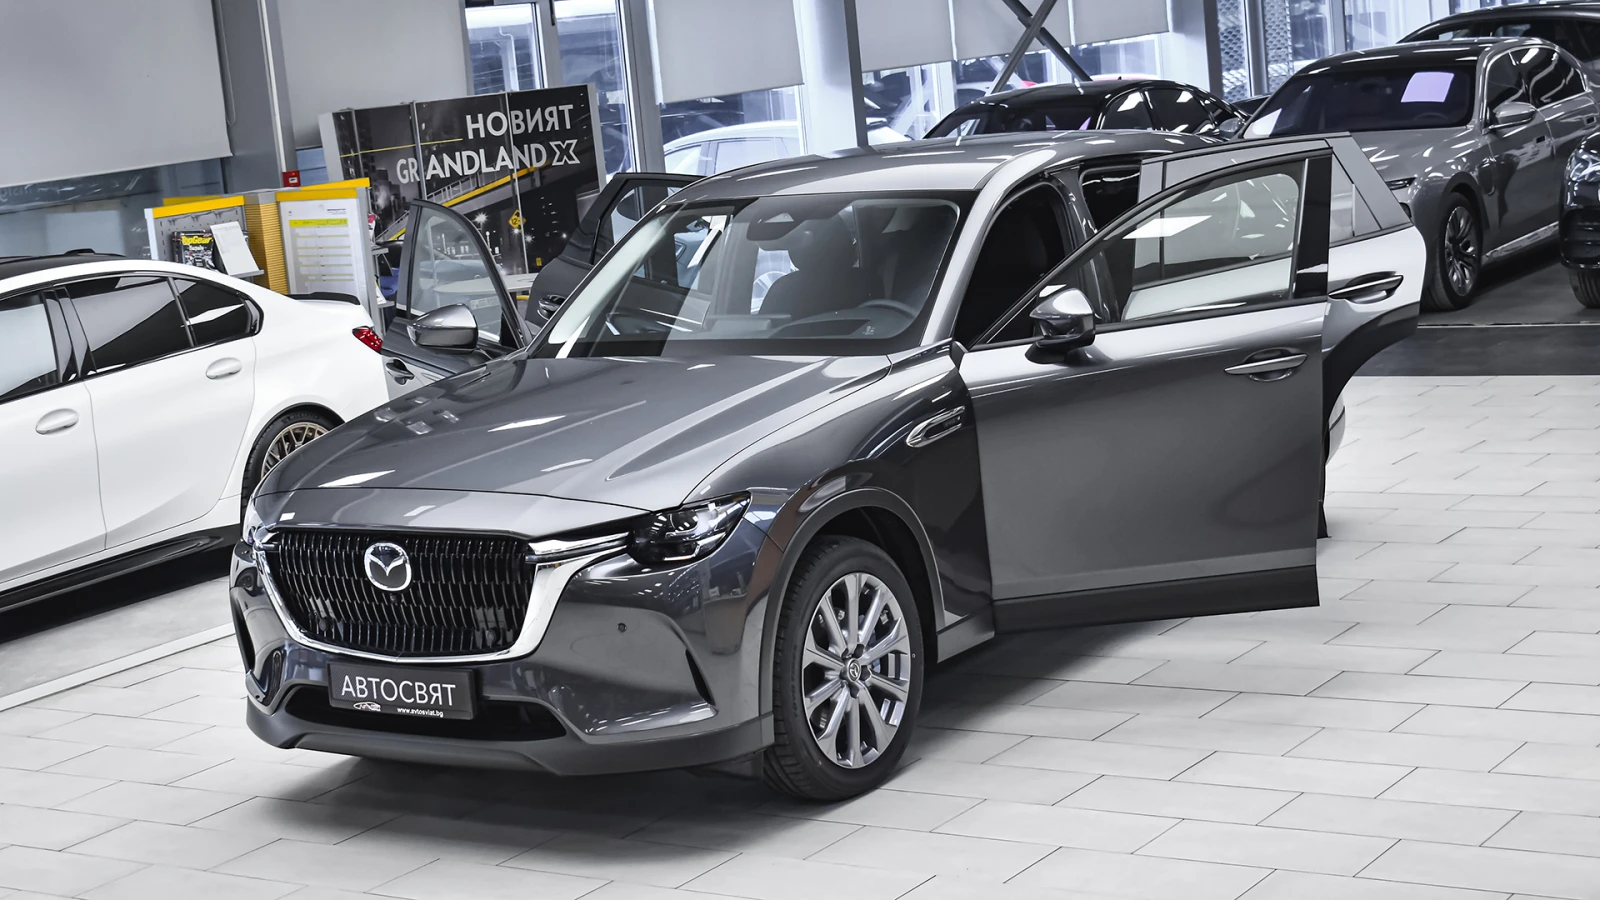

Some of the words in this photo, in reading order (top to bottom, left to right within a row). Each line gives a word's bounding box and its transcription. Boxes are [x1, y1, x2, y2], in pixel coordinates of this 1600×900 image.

[466, 105, 574, 139] НОВИЯТ
[397, 143, 547, 184] GRANDLAND
[551, 139, 580, 166] X
[181, 235, 213, 246] TopGear
[342, 676, 456, 706] АВТОСВЯТ
[397, 707, 444, 718] www.avtosviat.bg
